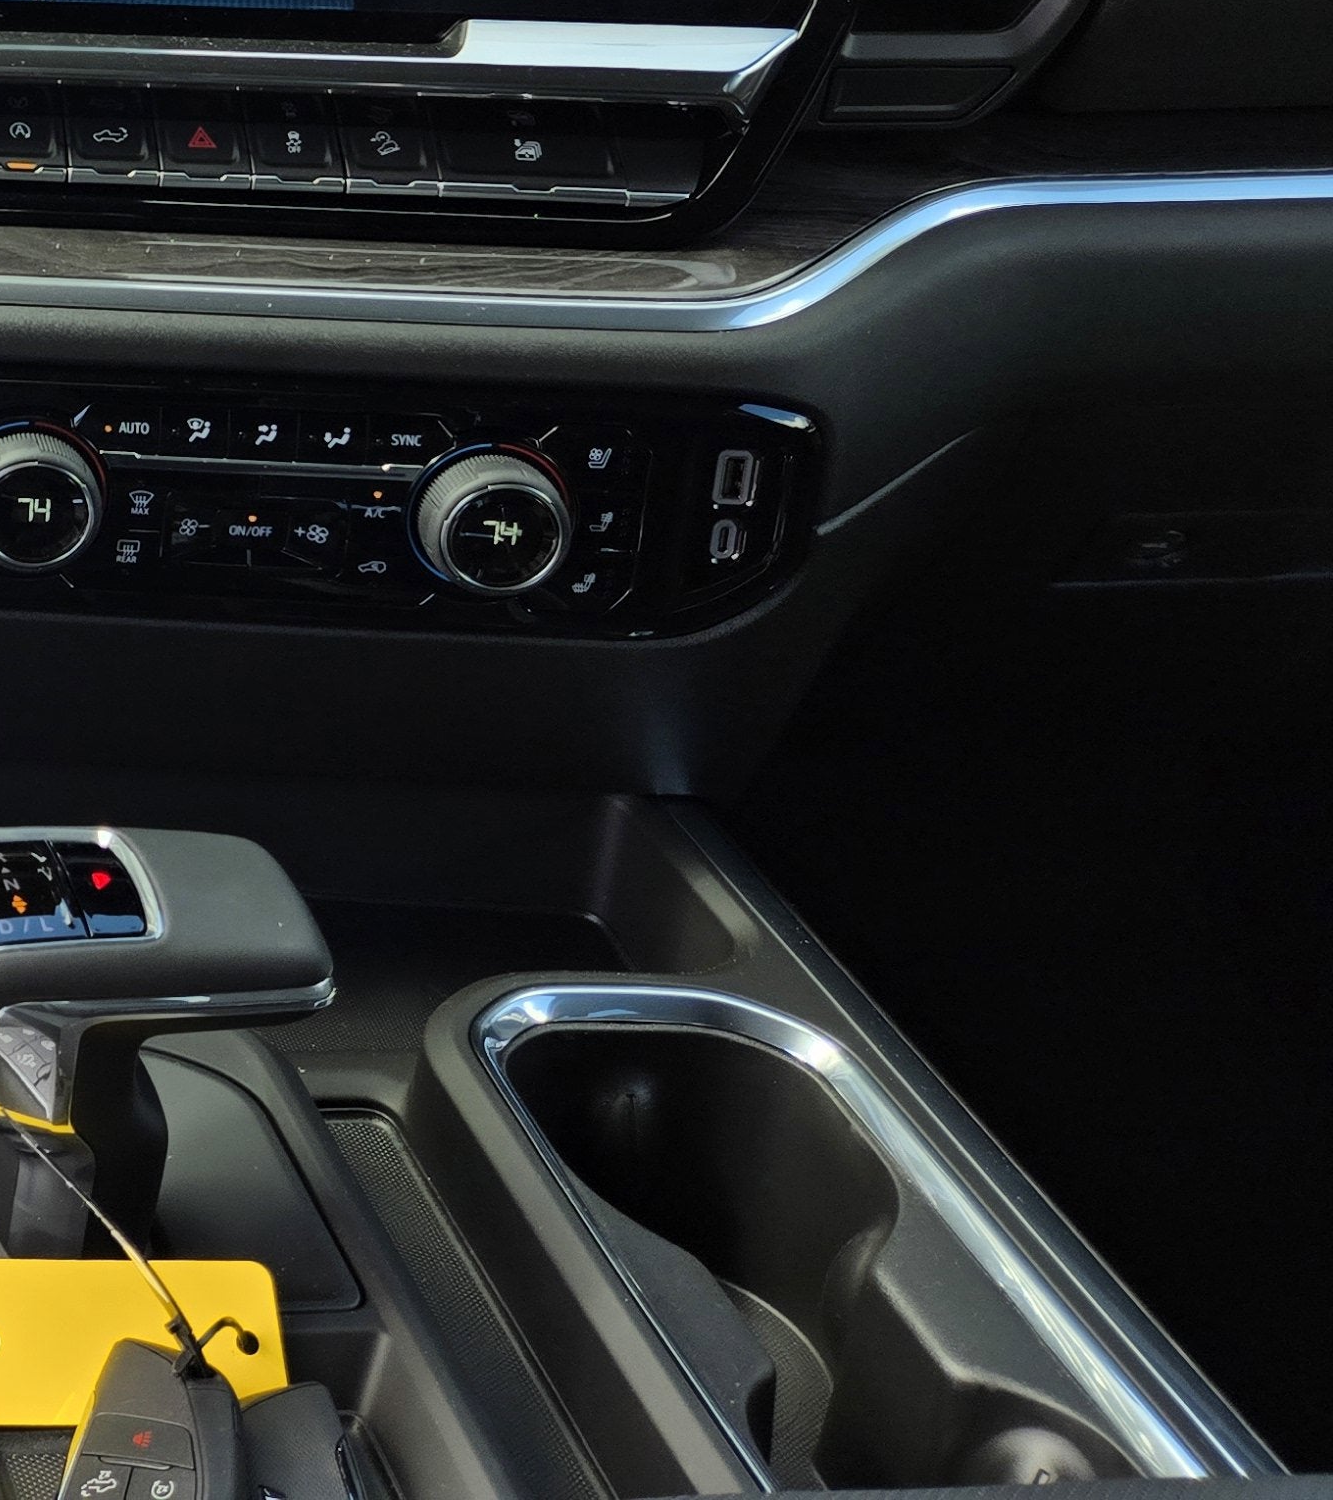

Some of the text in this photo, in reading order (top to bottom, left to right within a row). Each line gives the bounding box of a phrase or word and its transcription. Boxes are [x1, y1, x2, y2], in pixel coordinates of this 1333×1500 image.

[119, 422, 149, 434] AUTO
[391, 434, 421, 446] SYNC
[18, 498, 51, 522] 74
[131, 506, 149, 515] MAX
[364, 507, 385, 518] A/C
[229, 524, 273, 538] ON/OFF
[483, 521, 522, 545] 74
[116, 554, 137, 564] REAR
[2, 877, 21, 892] N
